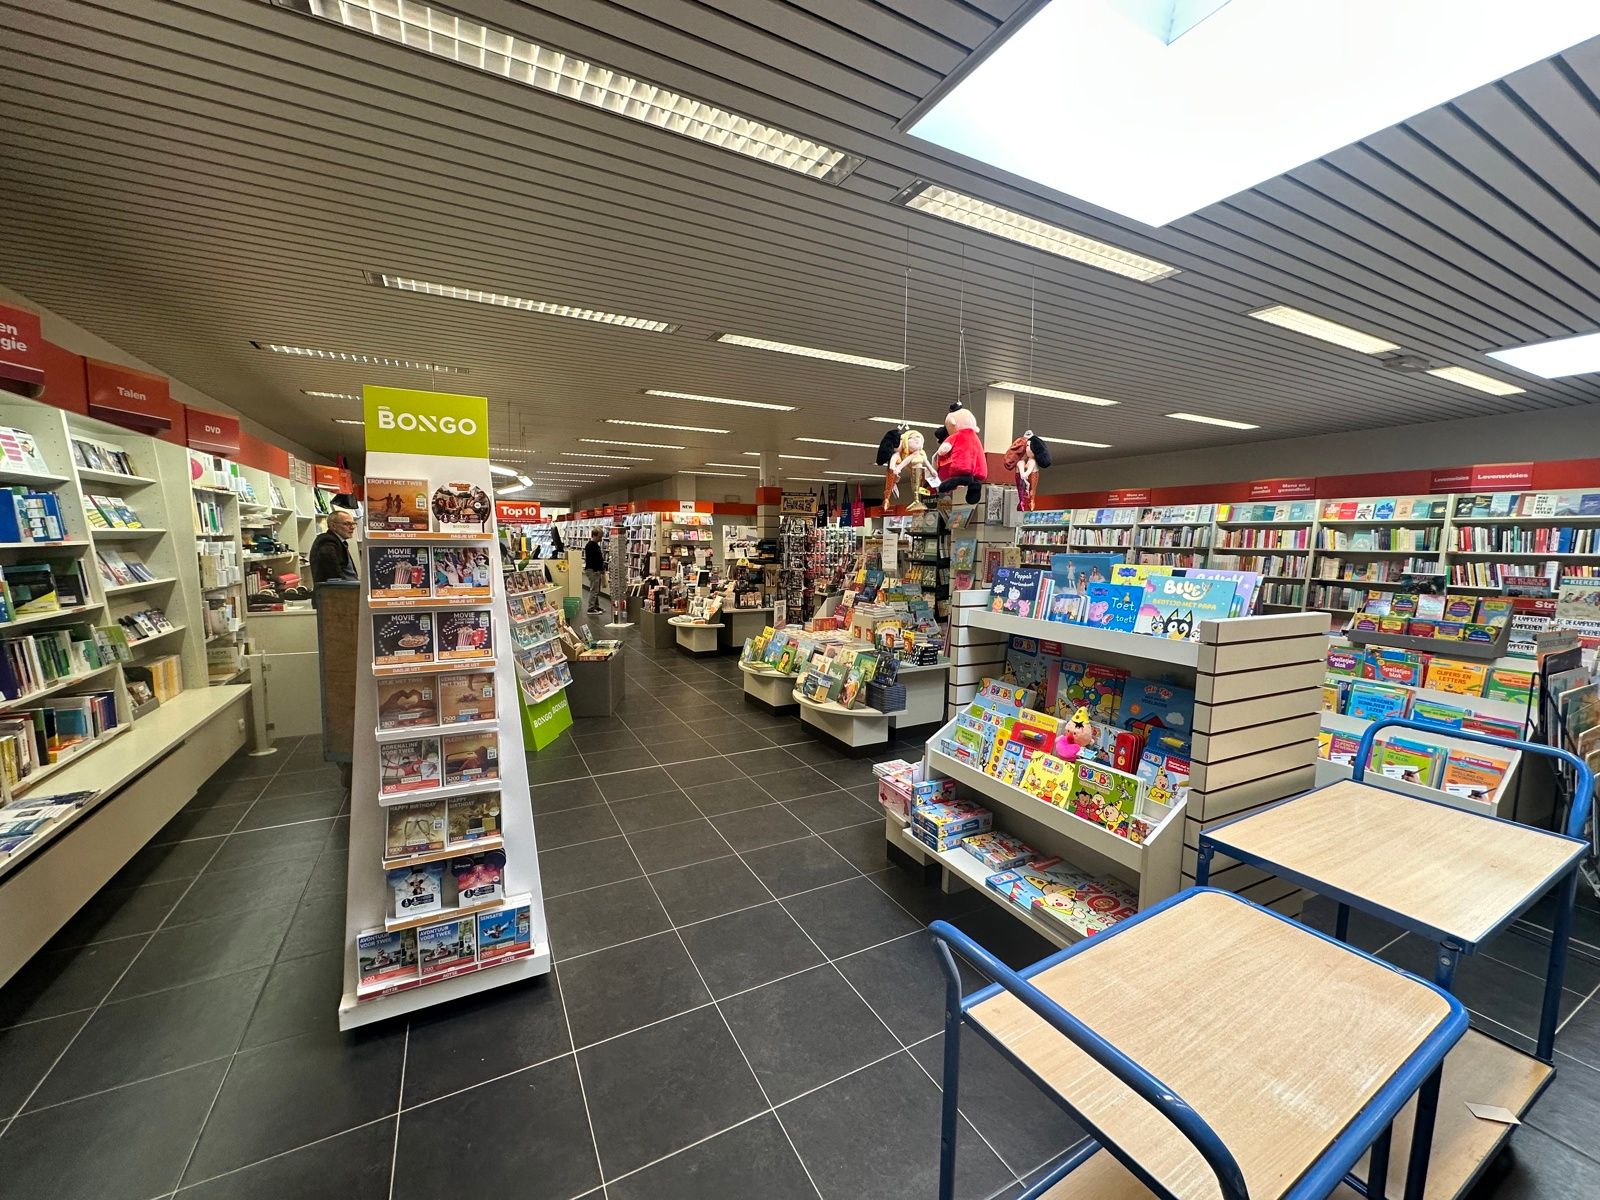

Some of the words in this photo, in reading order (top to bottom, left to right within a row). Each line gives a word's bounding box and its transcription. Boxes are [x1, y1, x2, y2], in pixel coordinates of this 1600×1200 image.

[117, 387, 146, 400] Talen
[378, 406, 477, 435] BONGO
[205, 425, 221, 434] DVD
[501, 506, 522, 517] Top
[523, 507, 536, 516] 10
[533, 712, 552, 728] BONGO
[480, 912, 503, 921] SENSATIE
[420, 926, 449, 936] AVONTUUR
[436, 929, 451, 937] TWEE
